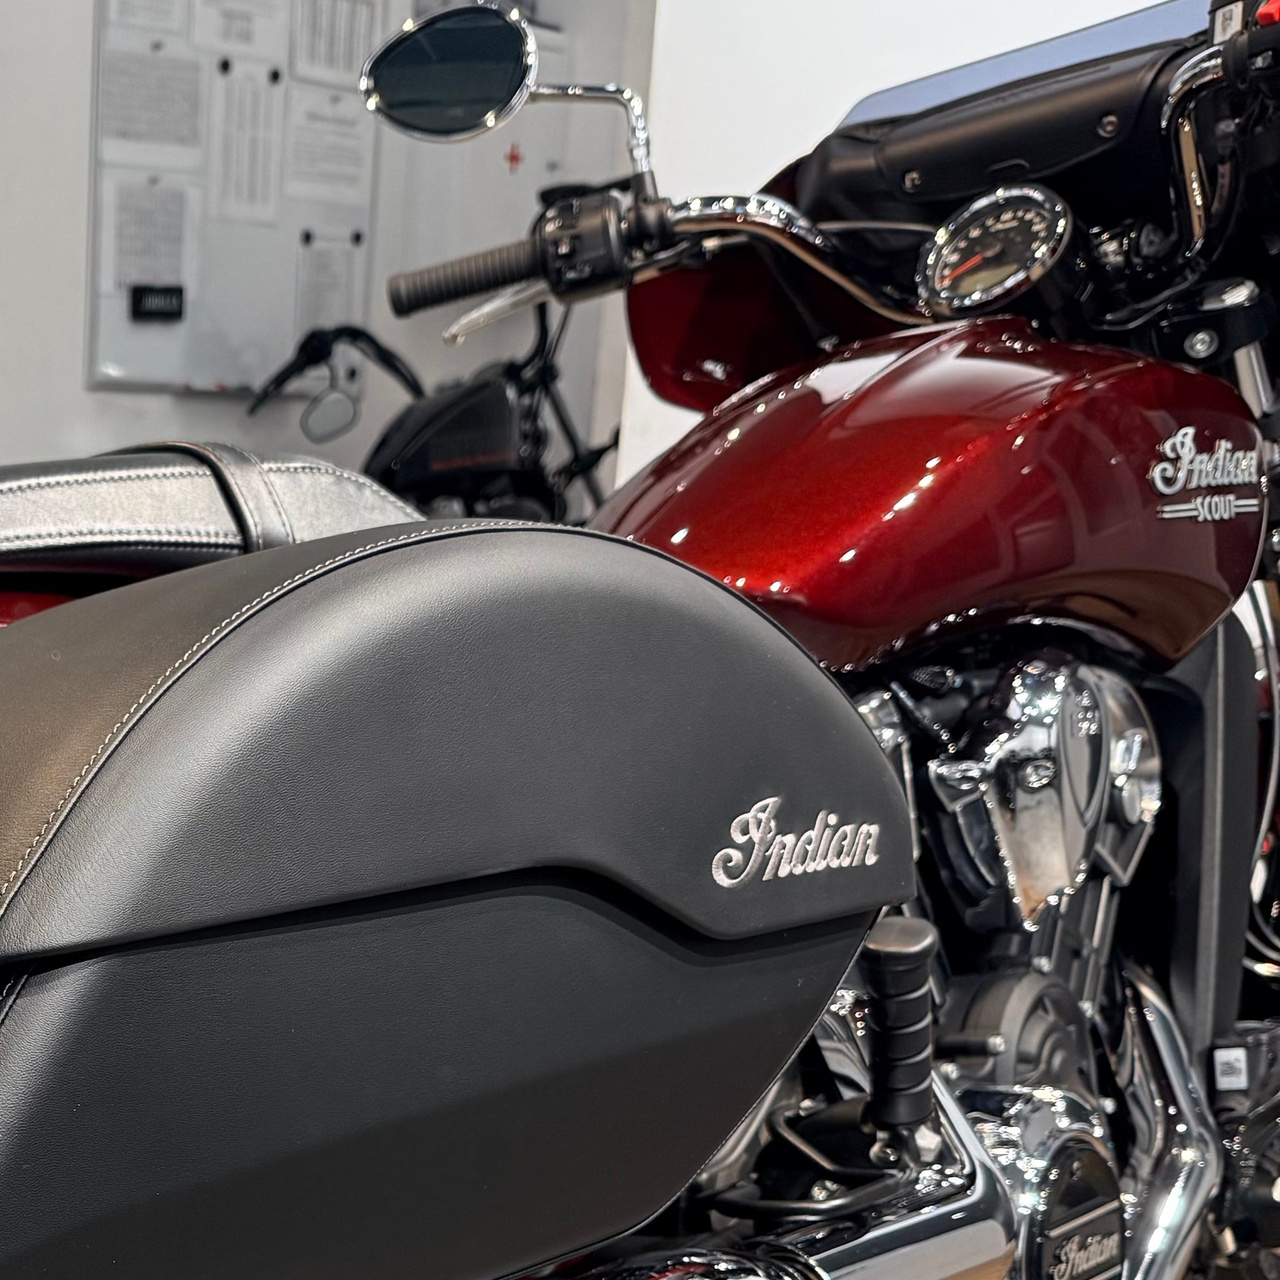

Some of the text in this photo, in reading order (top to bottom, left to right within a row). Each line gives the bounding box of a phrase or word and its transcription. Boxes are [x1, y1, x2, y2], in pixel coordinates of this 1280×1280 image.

[1153, 426, 1258, 495] Indian
[1195, 494, 1236, 522] SCOUT
[711, 796, 880, 888] Indian
